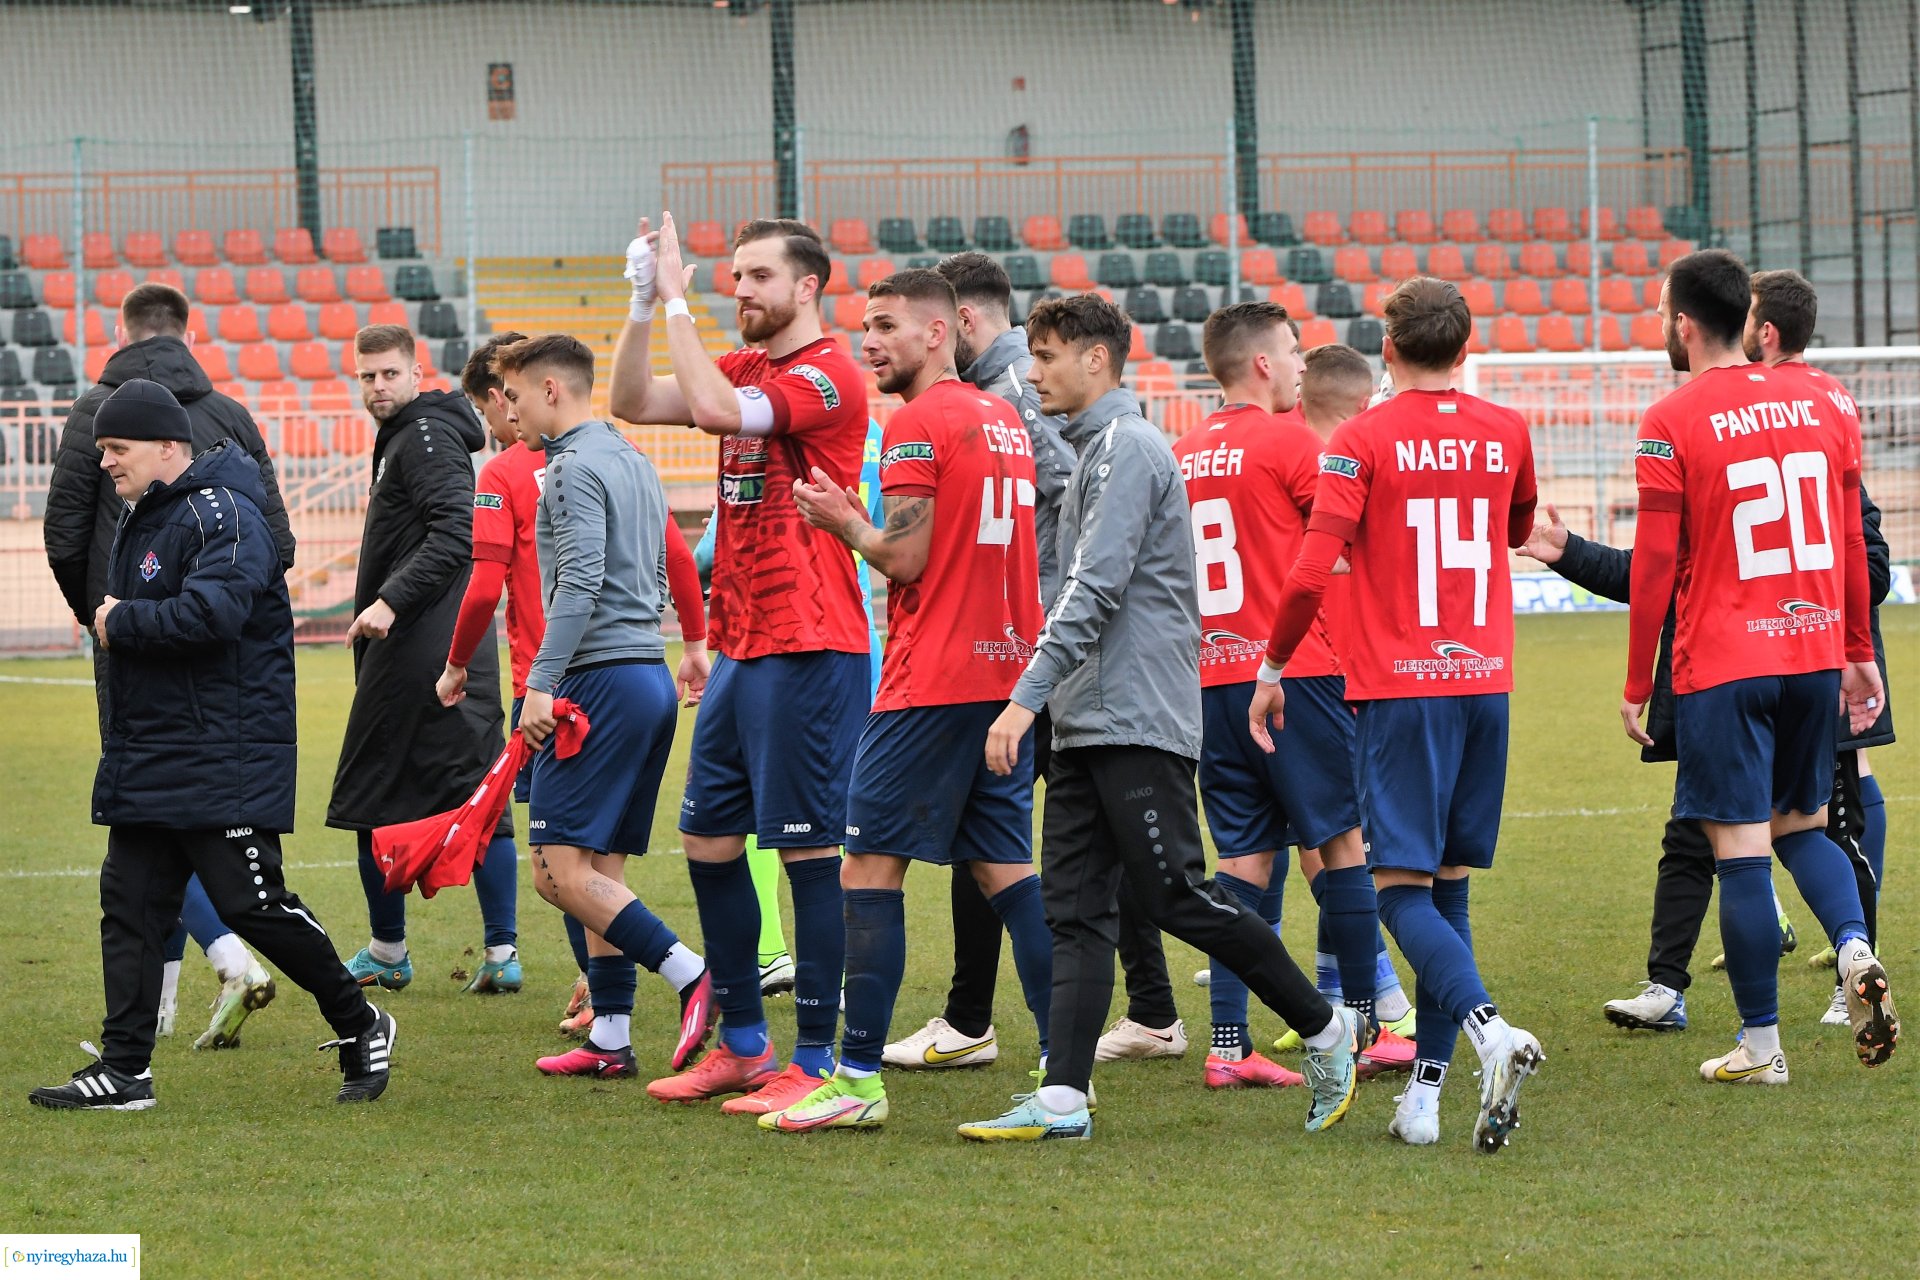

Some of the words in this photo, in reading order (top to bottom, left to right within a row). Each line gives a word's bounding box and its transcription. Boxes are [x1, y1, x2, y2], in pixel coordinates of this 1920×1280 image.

[1709, 400, 1820, 442] PANTOVIC
[1181, 442, 1244, 480] SIGÉR
[1395, 439, 1477, 471] NAGY
[1486, 441, 1509, 473] B.
[1726, 451, 1835, 580] 20
[1191, 497, 1244, 616] 8
[1406, 497, 1492, 626] 14
[1747, 615, 1804, 632] LERTON
[1394, 659, 1461, 673] LERTON
[1461, 656, 1504, 671] TRANS
[225, 827, 253, 839] JAKO
[530, 820, 547, 830] AKO
[782, 823, 811, 834] JAKO
